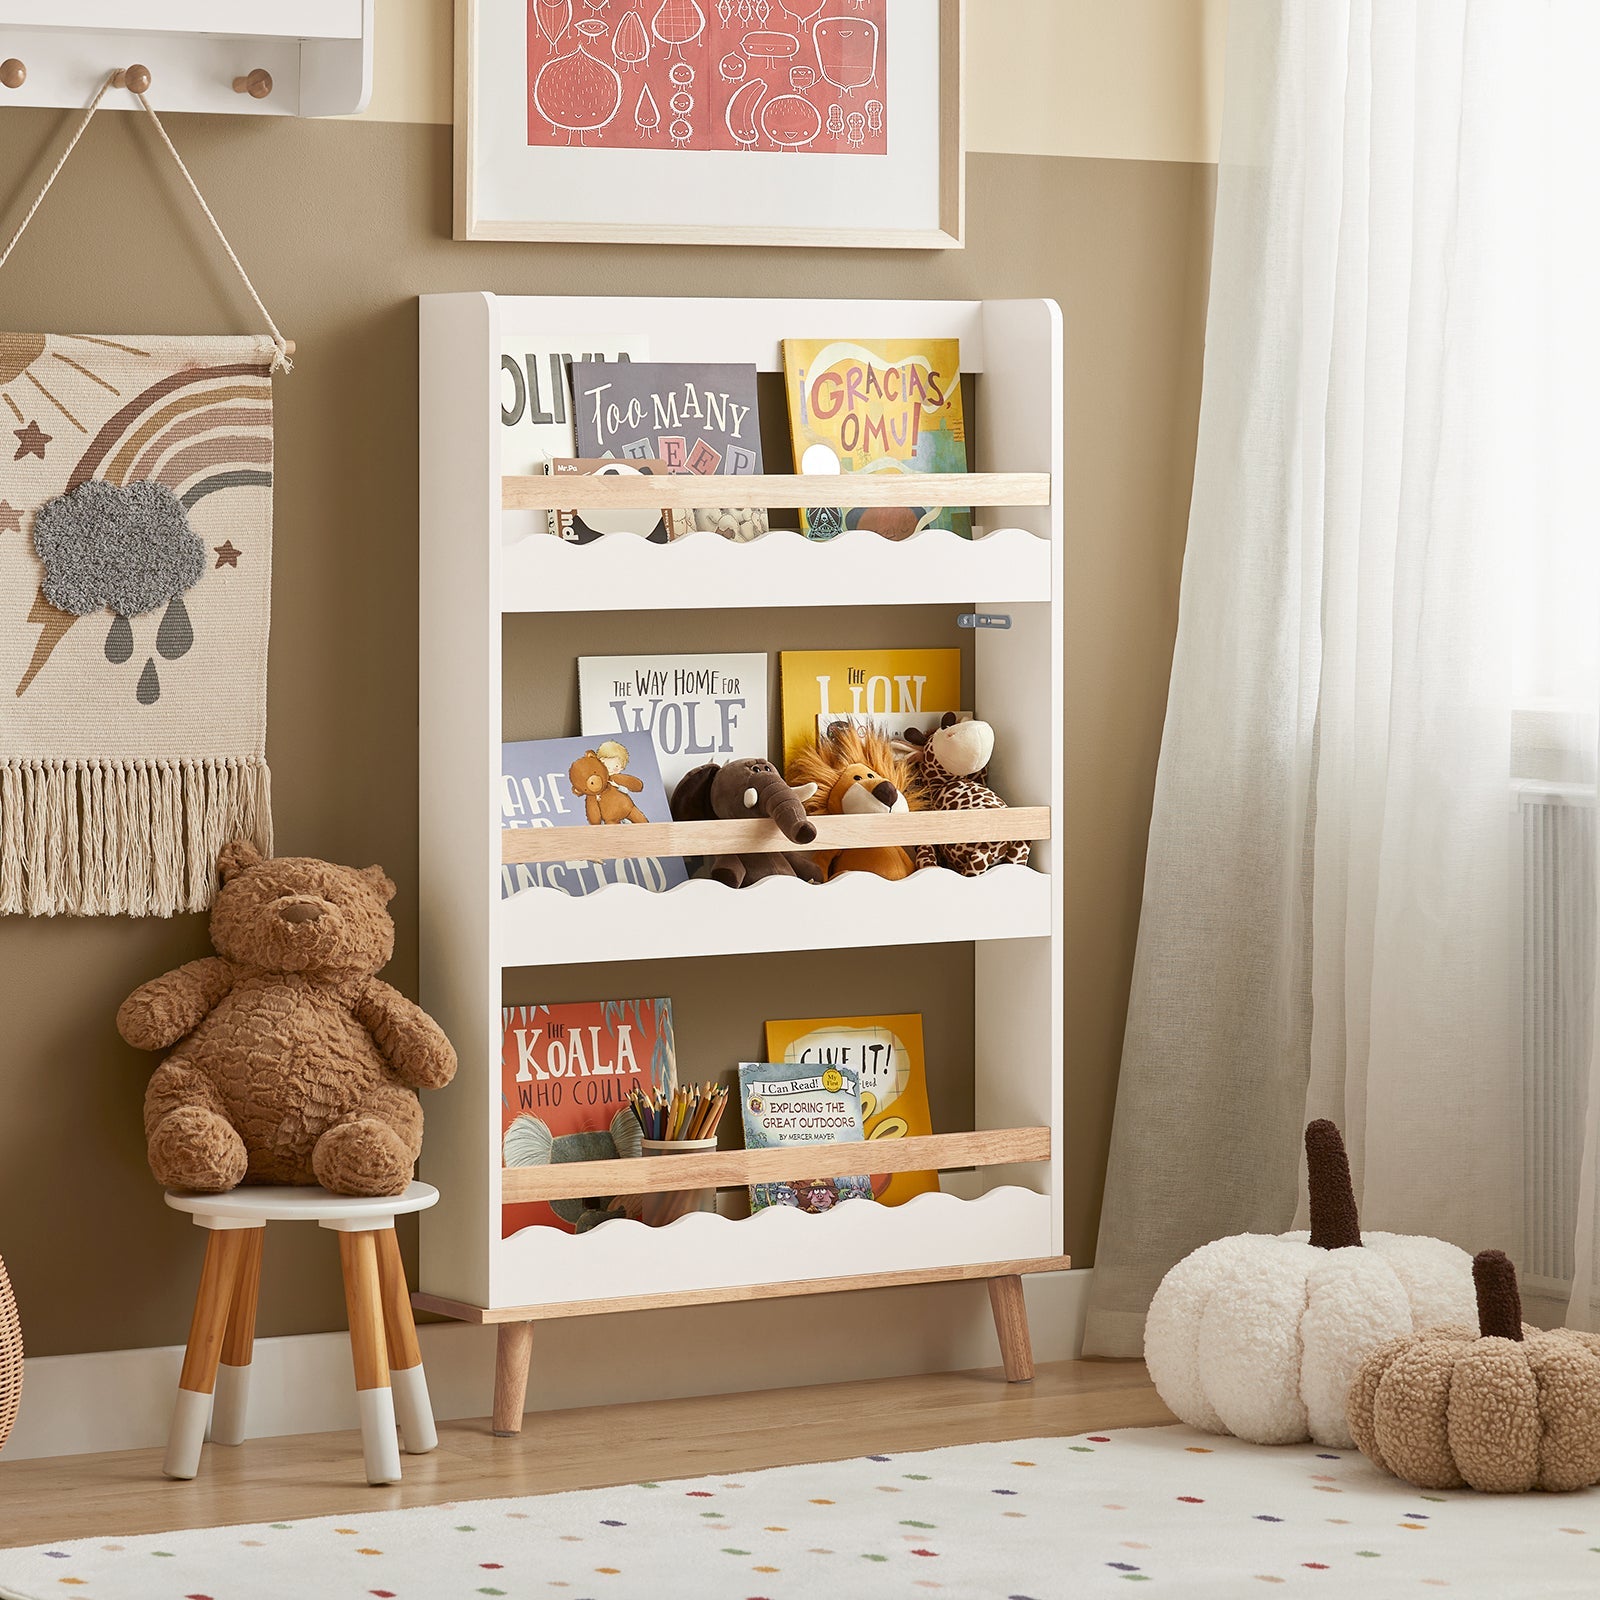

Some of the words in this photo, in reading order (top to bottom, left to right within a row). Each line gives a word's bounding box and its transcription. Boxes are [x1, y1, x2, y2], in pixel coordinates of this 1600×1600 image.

[501, 352, 631, 427] OLI
[584, 383, 648, 445] Too
[651, 382, 750, 438] MANY
[841, 401, 922, 457] OMU!
[628, 441, 749, 475] HEEP
[613, 680, 632, 697] THE
[635, 669, 668, 697] WAY
[674, 669, 720, 696] HOME
[722, 678, 741, 695] FOR
[847, 667, 866, 685] THE
[816, 675, 927, 713] LION
[609, 698, 746, 755] WOLF
[501, 773, 571, 817] AKE
[547, 1021, 565, 1040] THE
[862, 1044, 892, 1075] IT!
[518, 1082, 563, 1110] WHO
[761, 1083, 766, 1094] I
[768, 1083, 789, 1094] Can
[791, 1079, 819, 1090] Read!
[770, 1102, 824, 1114] EXPLORING
[826, 1102, 846, 1113] THE
[762, 1118, 797, 1129] GREAT
[799, 1117, 856, 1128] OUTDOORS
[788, 1133, 813, 1141] MERCER
[813, 1132, 835, 1140] MAYER
